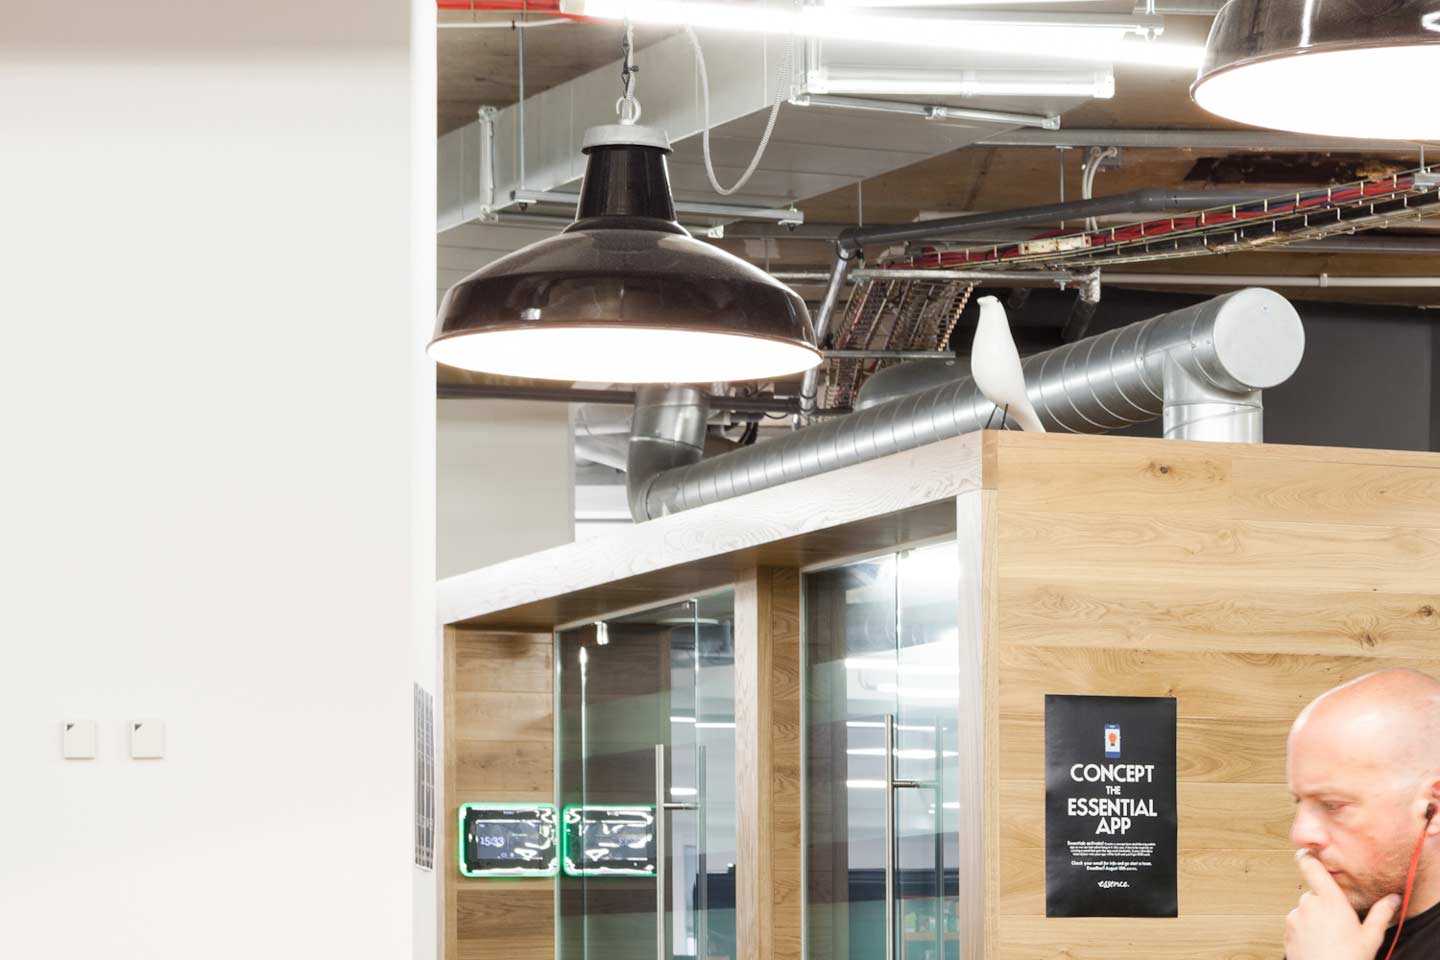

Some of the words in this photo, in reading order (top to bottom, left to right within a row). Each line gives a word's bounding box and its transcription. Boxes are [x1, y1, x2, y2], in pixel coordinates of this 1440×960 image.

[1070, 764, 1154, 782] CONCEPT
[1105, 786, 1121, 795] THE
[1067, 798, 1157, 817] ESSENTIAL
[1095, 817, 1131, 834] APP
[479, 836, 505, 847] 15:33
[1097, 880, 1130, 888] essence.
